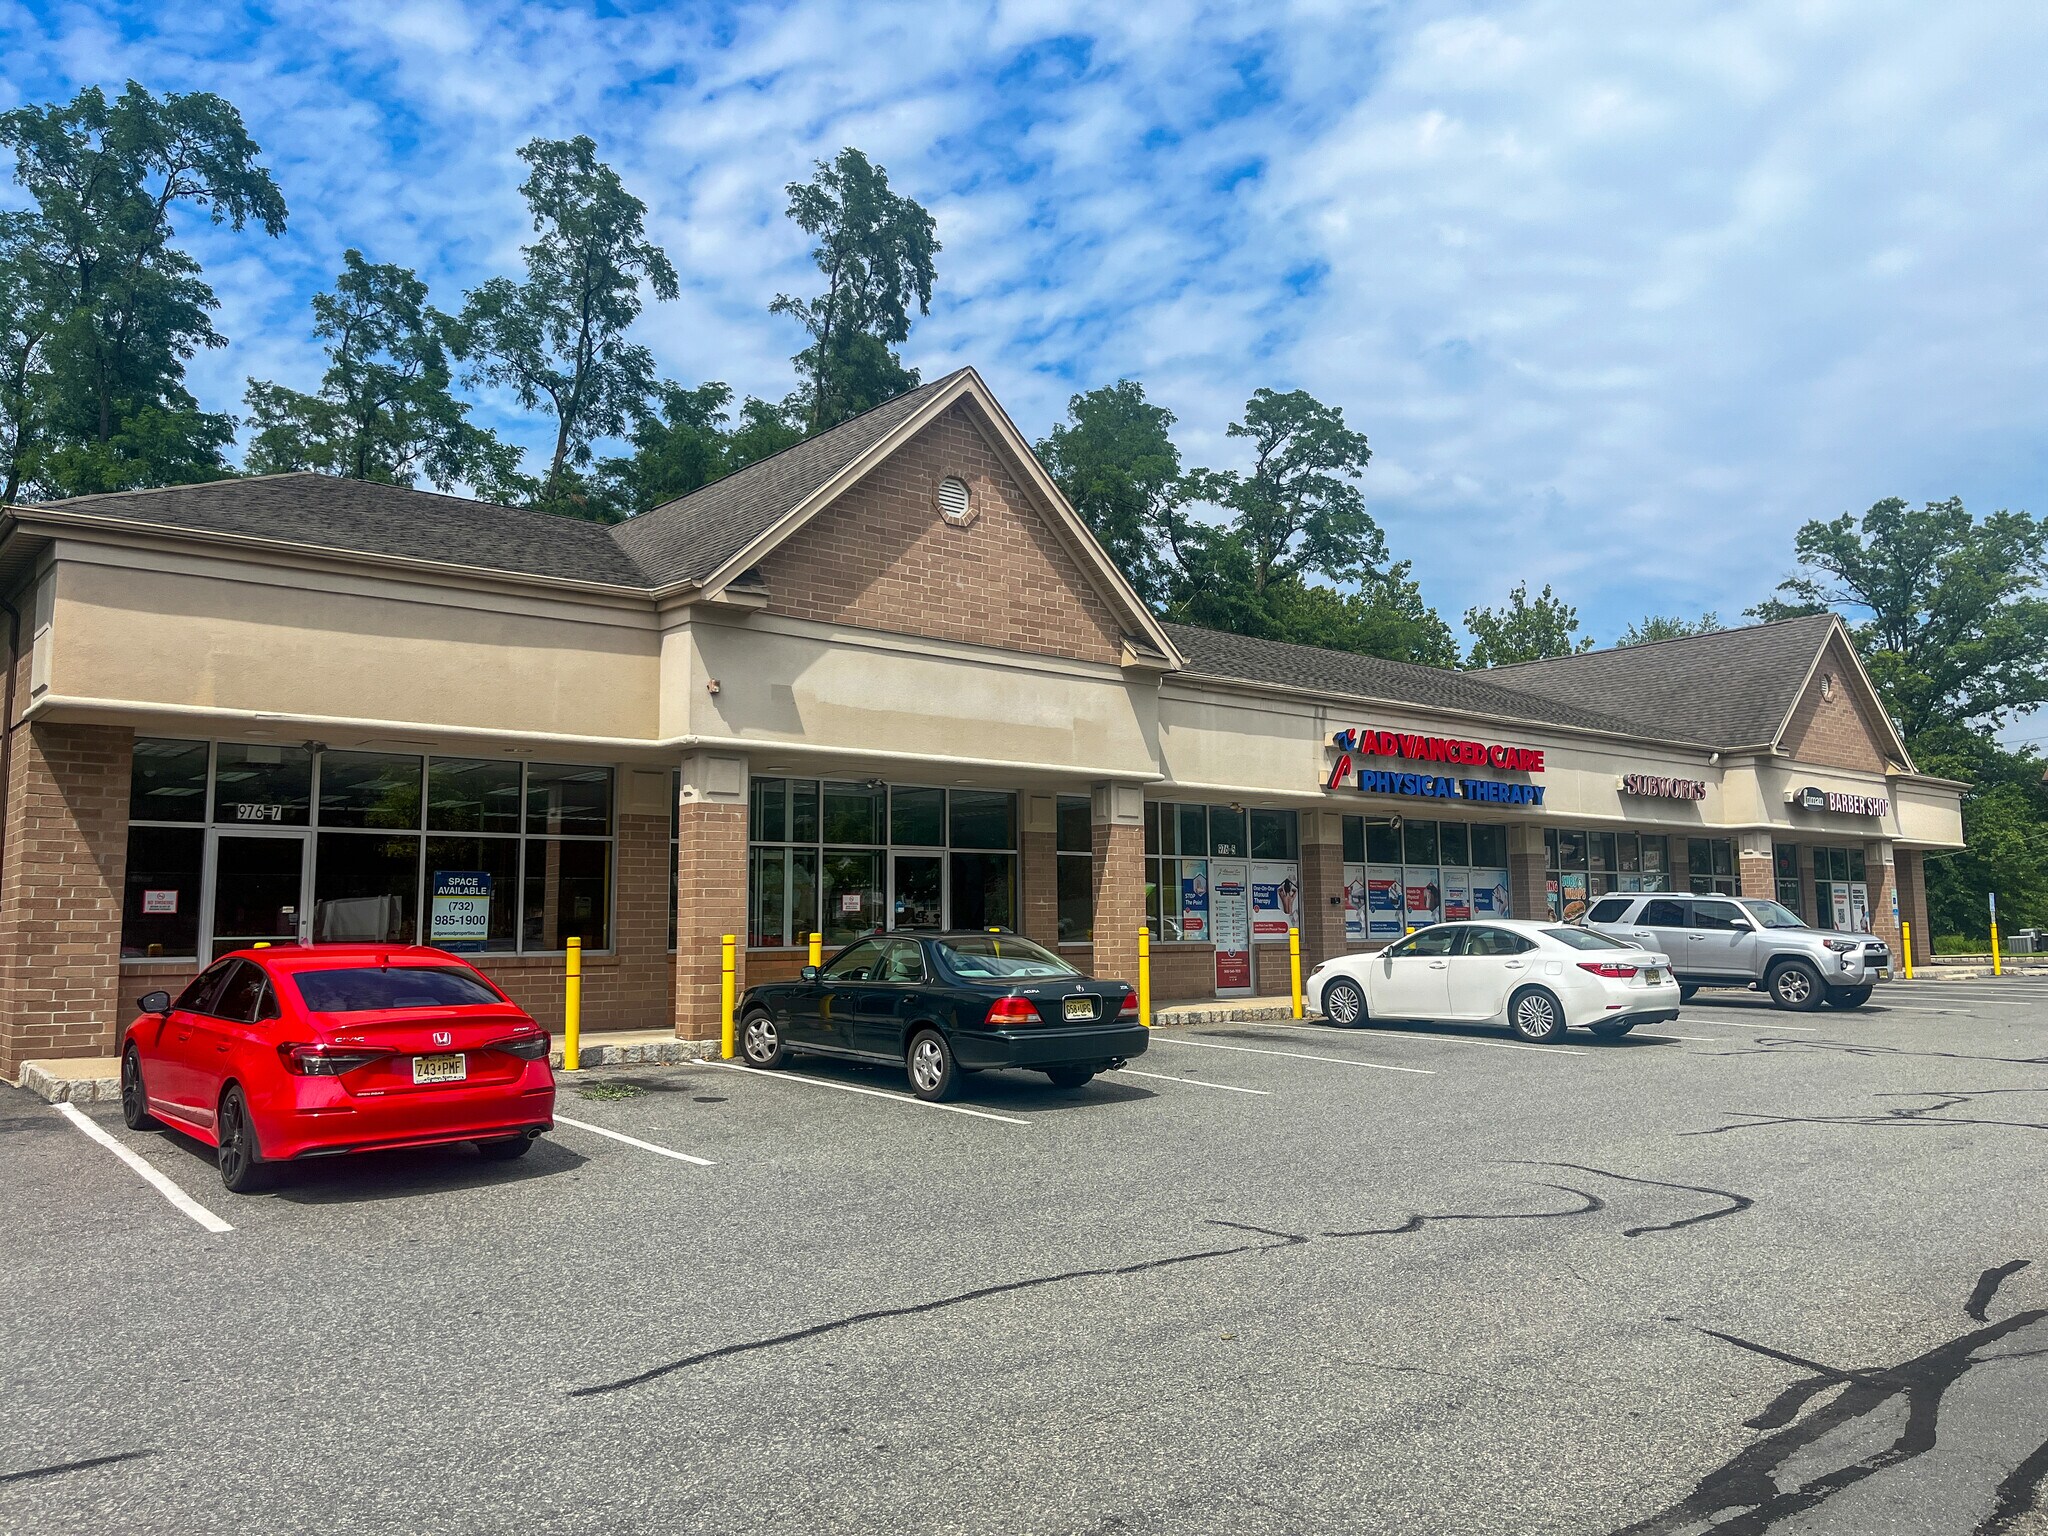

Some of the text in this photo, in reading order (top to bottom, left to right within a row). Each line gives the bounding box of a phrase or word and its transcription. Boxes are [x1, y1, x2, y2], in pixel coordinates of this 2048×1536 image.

[1359, 730, 1545, 772] ADVANCED CARE
[1358, 770, 1546, 805] PHYSICAL THERAPY
[1627, 774, 1707, 800] SUBWORKS
[1829, 792, 1890, 817] BARBER SHOP
[238, 804, 281, 820] 976-7
[448, 877, 478, 885] SPACE
[437, 886, 487, 894] AVAILABLE
[1564, 888, 1587, 900] WRAPS
[448, 902, 474, 912] (732)
[434, 915, 486, 925] 985-1900
